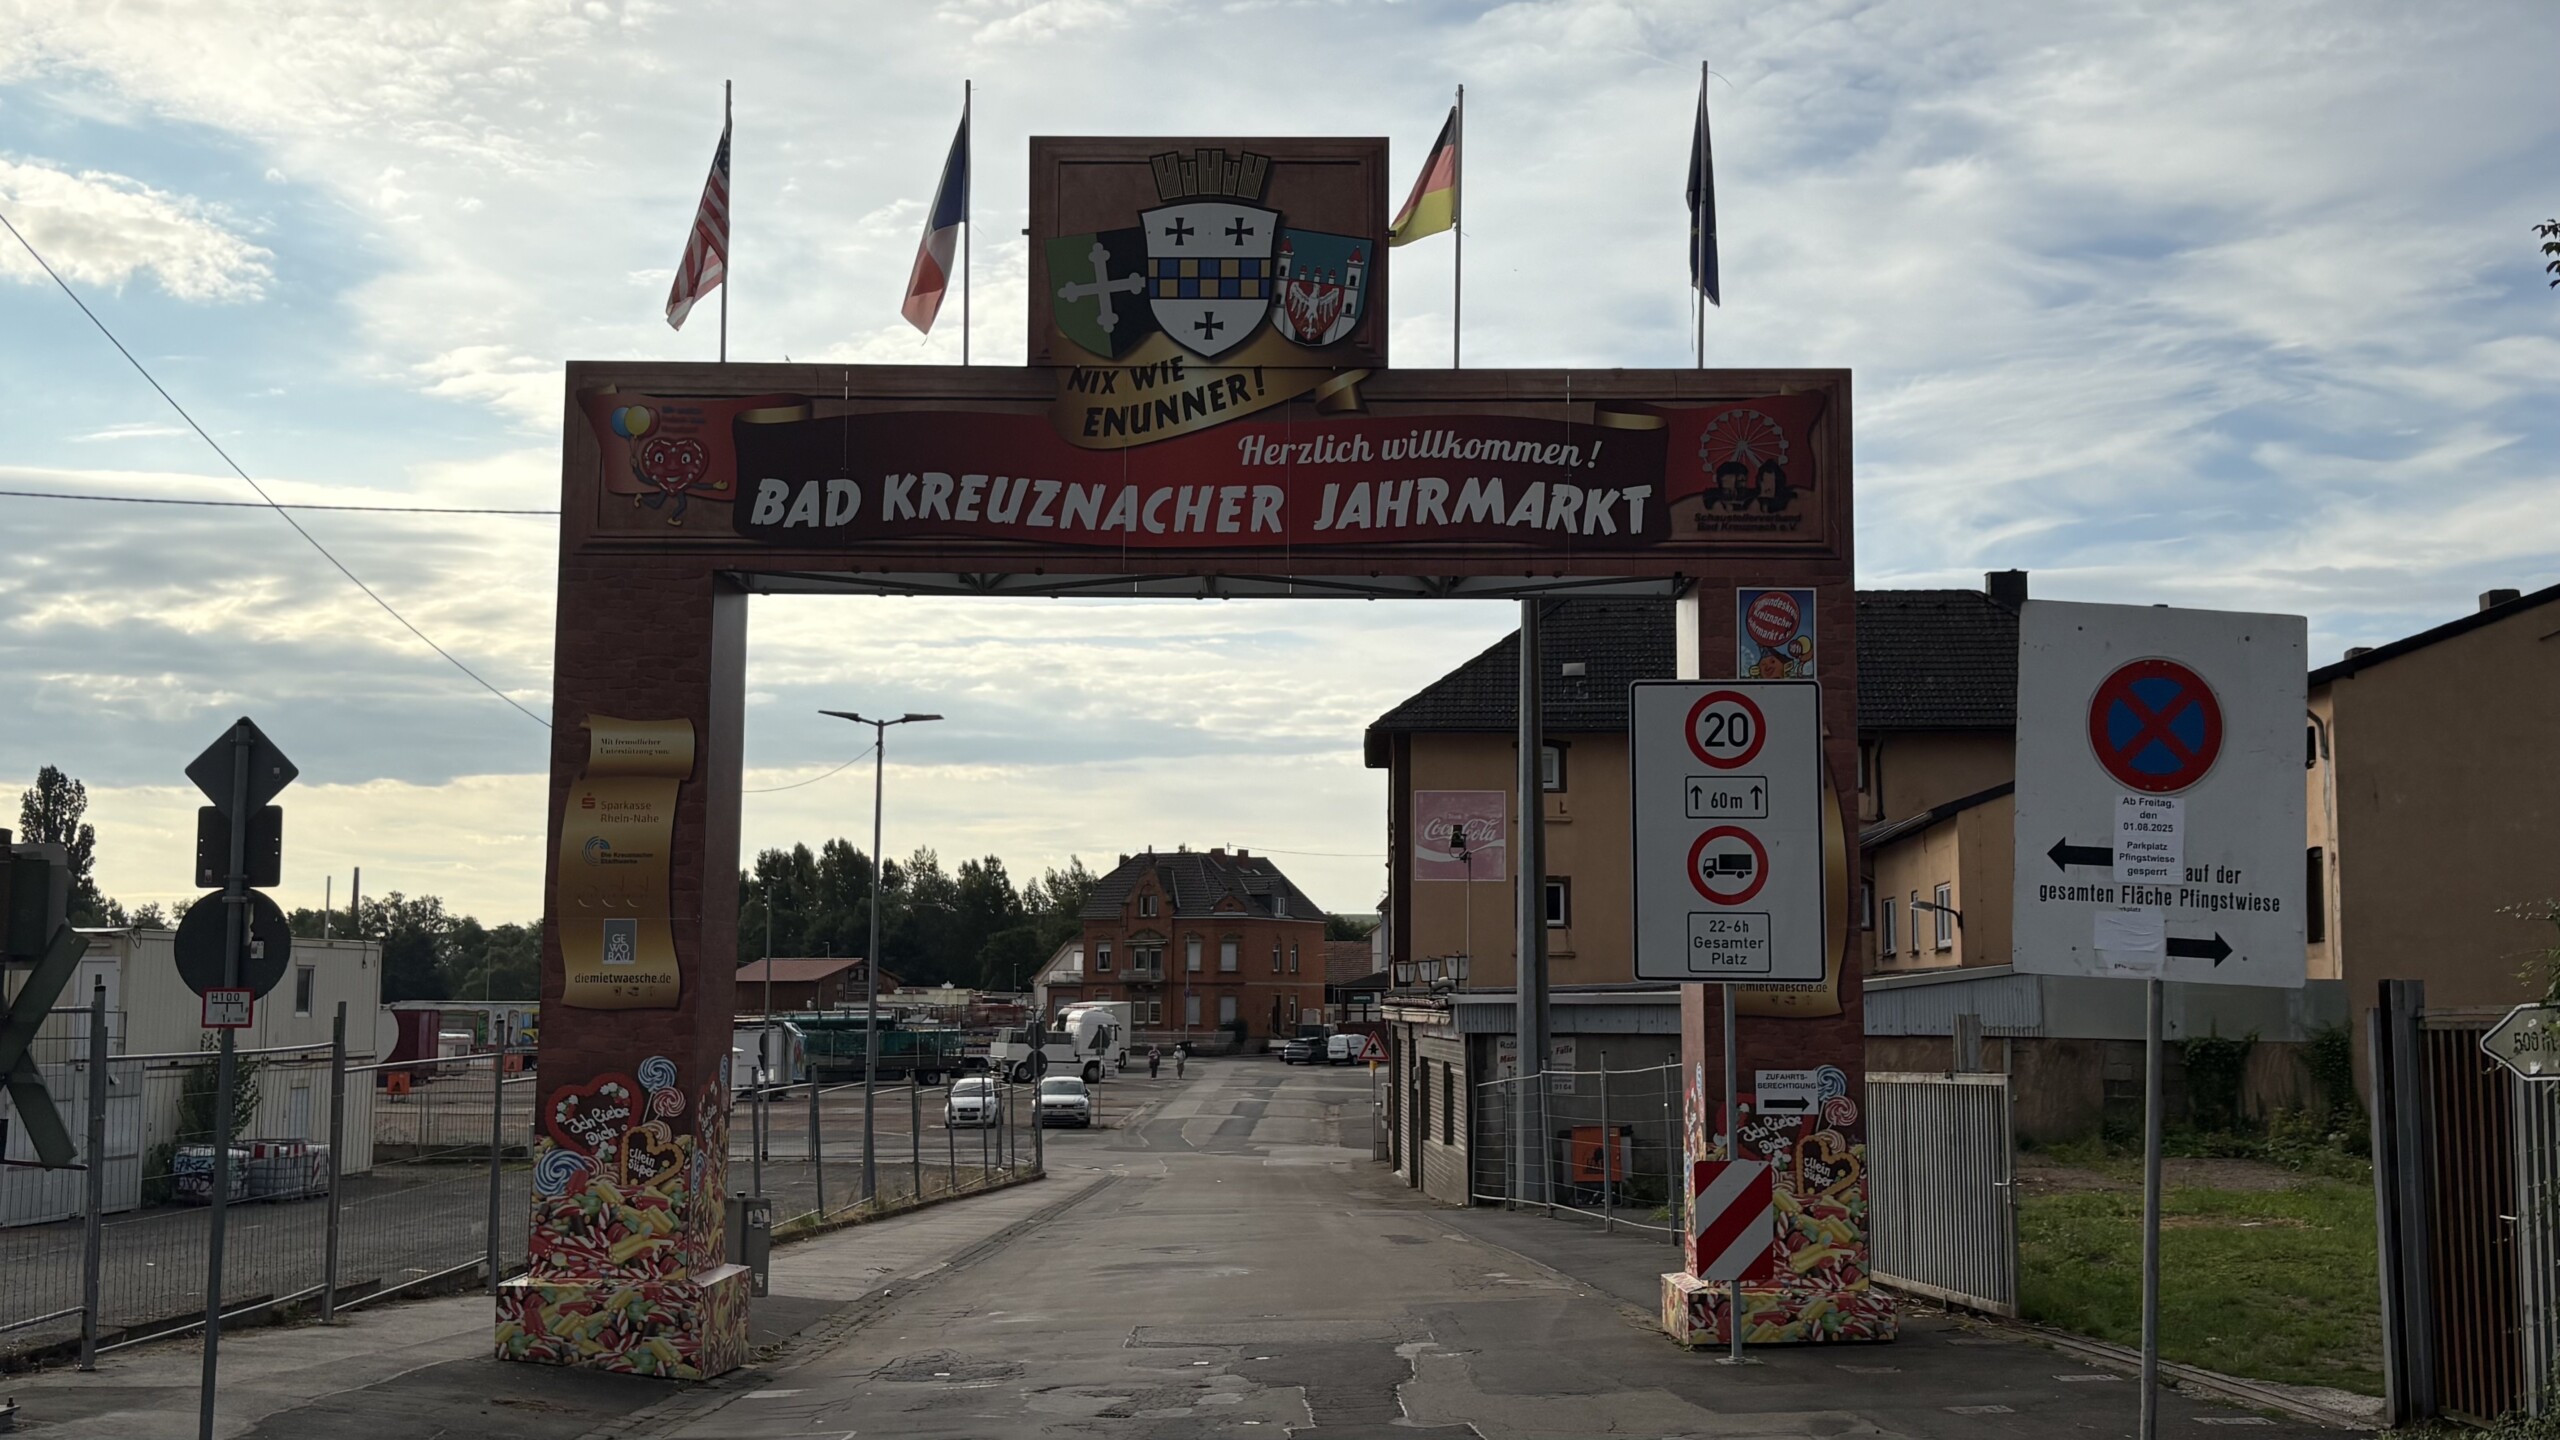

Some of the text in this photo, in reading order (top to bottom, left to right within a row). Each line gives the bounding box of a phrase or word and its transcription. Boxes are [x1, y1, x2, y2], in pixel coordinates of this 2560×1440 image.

[1067, 355, 1185, 395] NIX WIE
[1082, 366, 1265, 437] ENUNNER!
[1237, 430, 1374, 466] Herzlich
[751, 472, 1652, 536] BAD KREUZNACHER JAHRMARKT
[1704, 712, 1749, 747] 20
[601, 800, 652, 812] Sparkasse
[2122, 797, 2136, 806] Ab
[601, 813, 659, 824] Rhein-Nahe
[2139, 811, 2158, 820] den
[2123, 822, 2174, 833] 01.08.2025
[2127, 841, 2168, 852] Parkplatz
[2119, 853, 2175, 865] Pfingstwiese
[2127, 867, 2167, 878] gesperrt
[2185, 864, 2242, 885] auf der
[2039, 884, 2281, 912] gesamten Fläche Pfingstwiese
[612, 933, 627, 944] GE
[1694, 936, 1764, 949] Gesamter
[609, 943, 630, 953] WO
[608, 952, 630, 961] BAU
[1712, 953, 1748, 966] Platz
[574, 971, 672, 984] diemietwaesche.de
[1757, 1082, 1817, 1090] BERECHTIGUNG
[564, 1105, 630, 1133] Ich liebe
[585, 1123, 619, 1145] Dich
[1737, 1122, 1769, 1142] Ich
[1758, 1131, 1793, 1154] Dich
[629, 1148, 656, 1168] Mein
